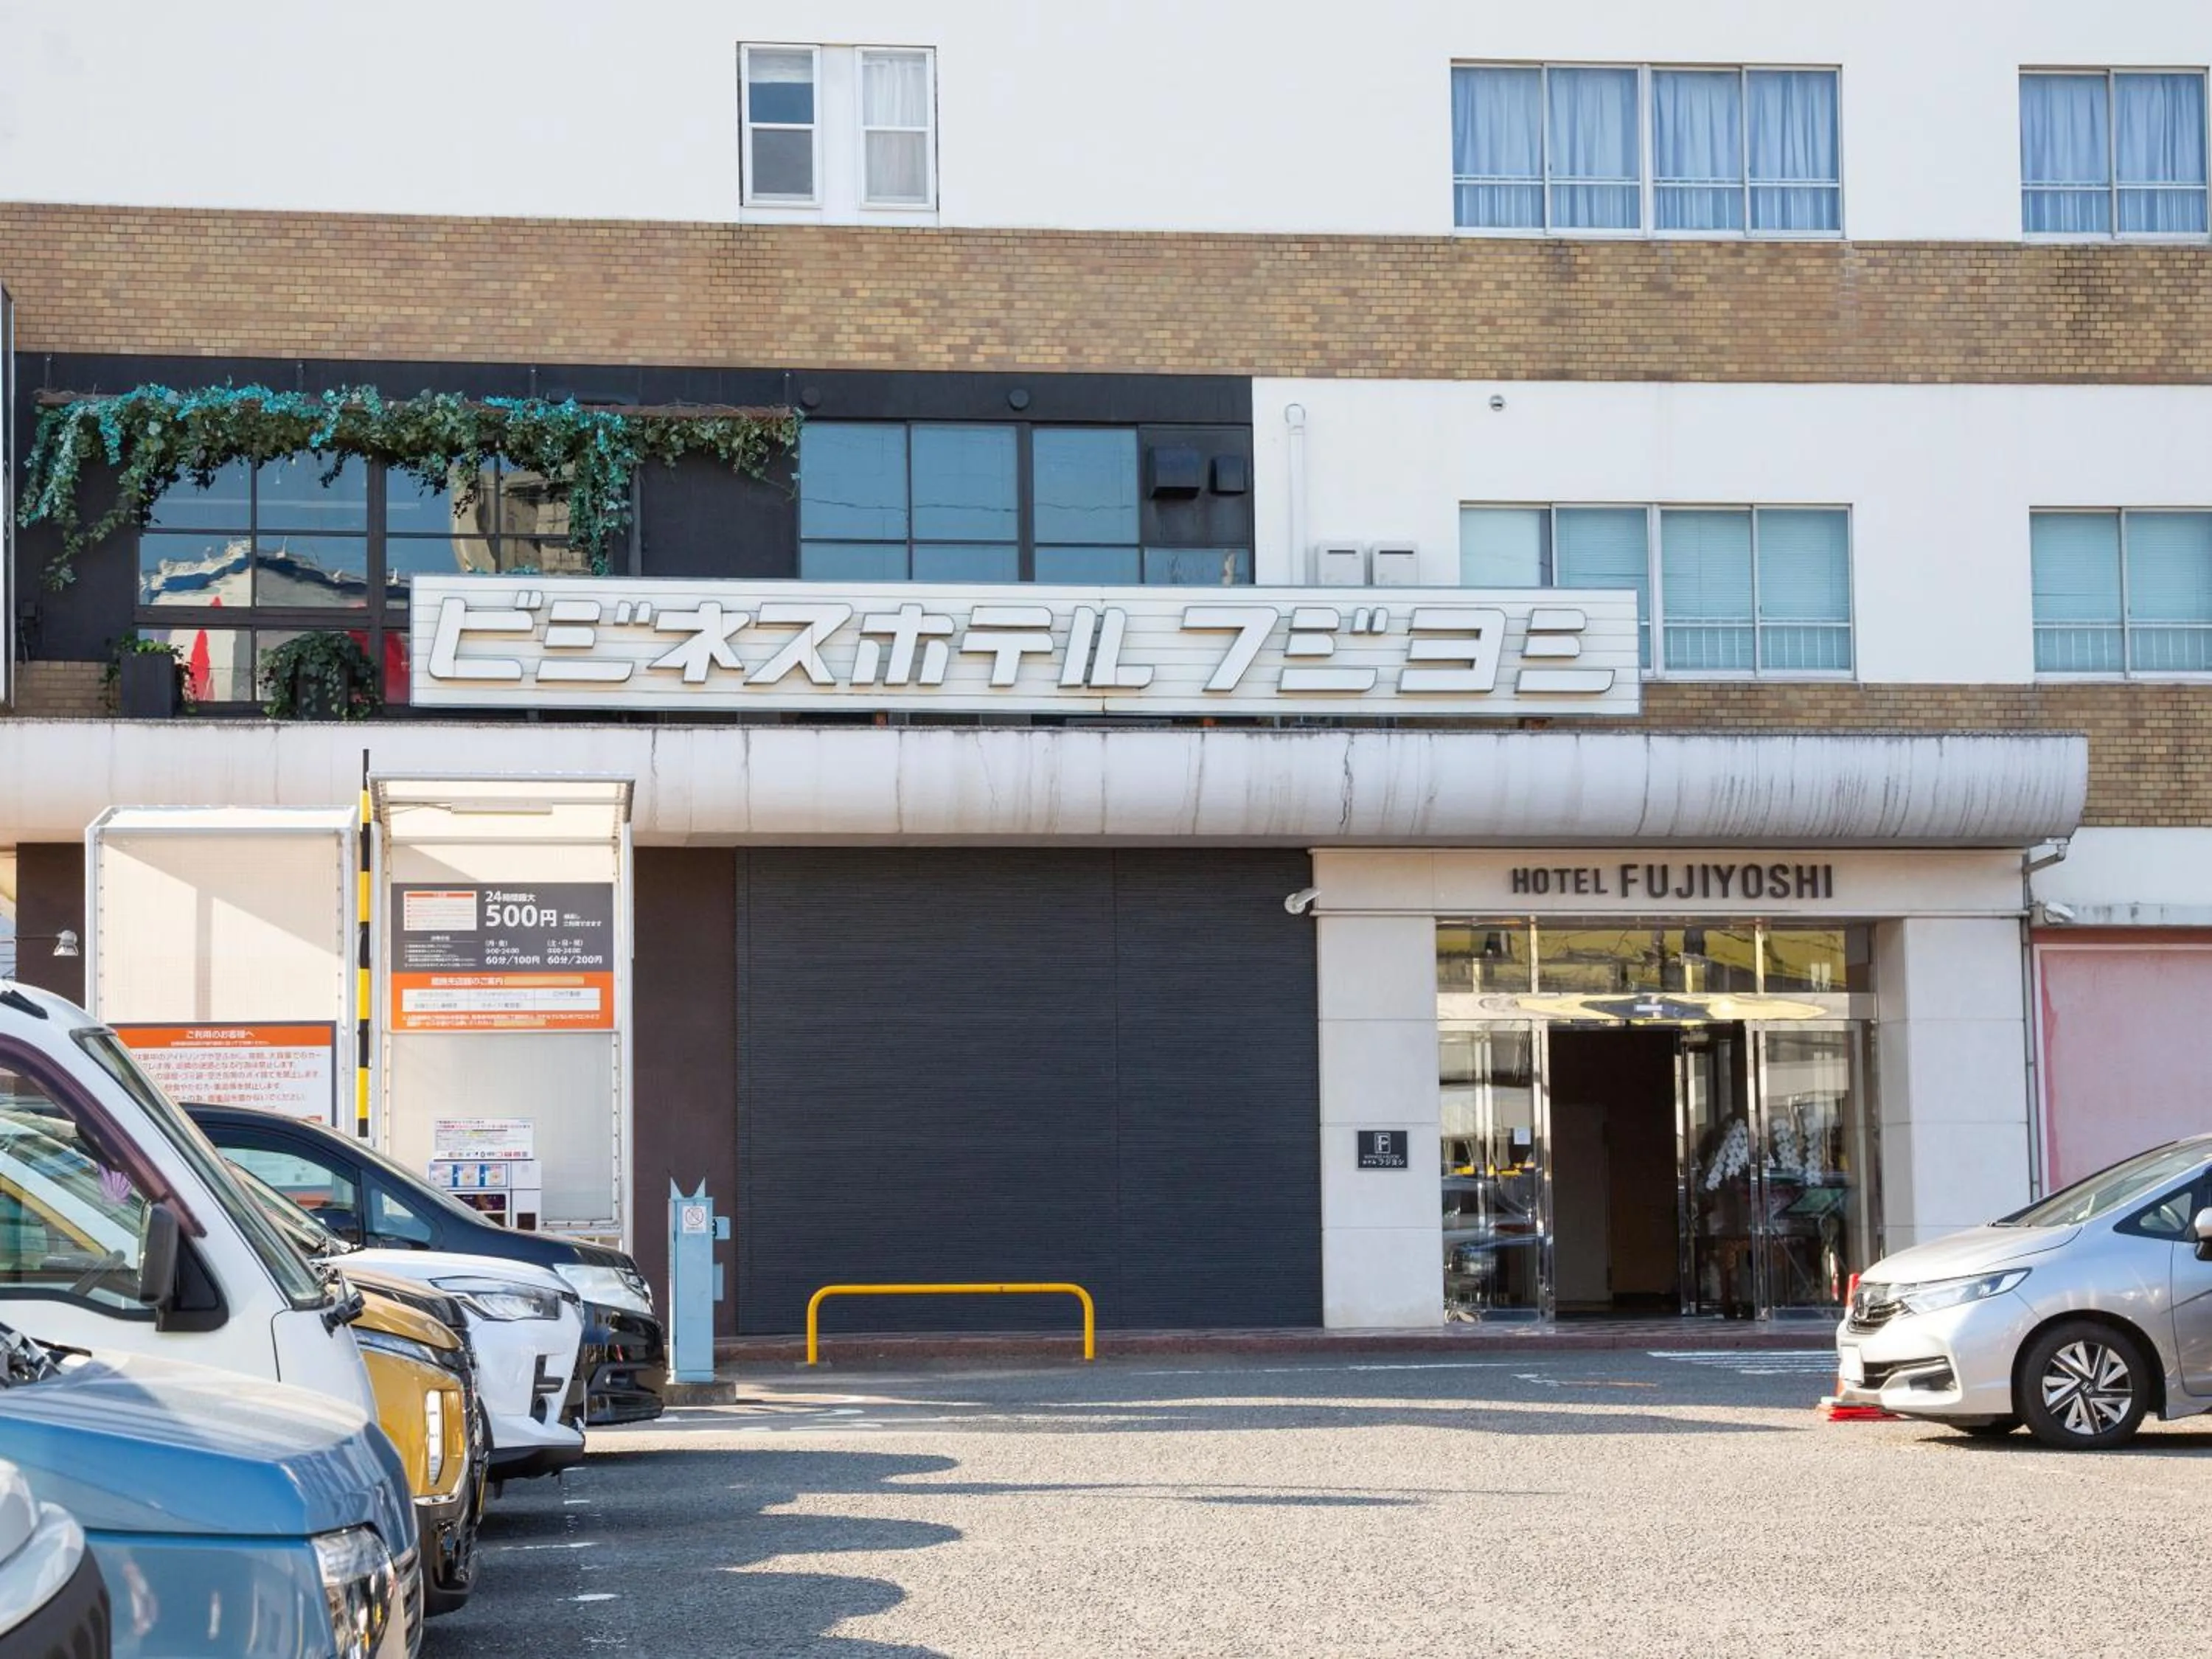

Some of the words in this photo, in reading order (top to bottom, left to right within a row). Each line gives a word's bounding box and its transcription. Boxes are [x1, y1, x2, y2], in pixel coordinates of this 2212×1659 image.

[428, 588, 1155, 689] ビジネスホテル
[1512, 867, 1609, 894] HOTEL
[1620, 863, 1834, 899] FUJIYOSHI
[485, 905, 557, 928] 500円
[185, 1029, 255, 1040] ご利用のお客様へ
